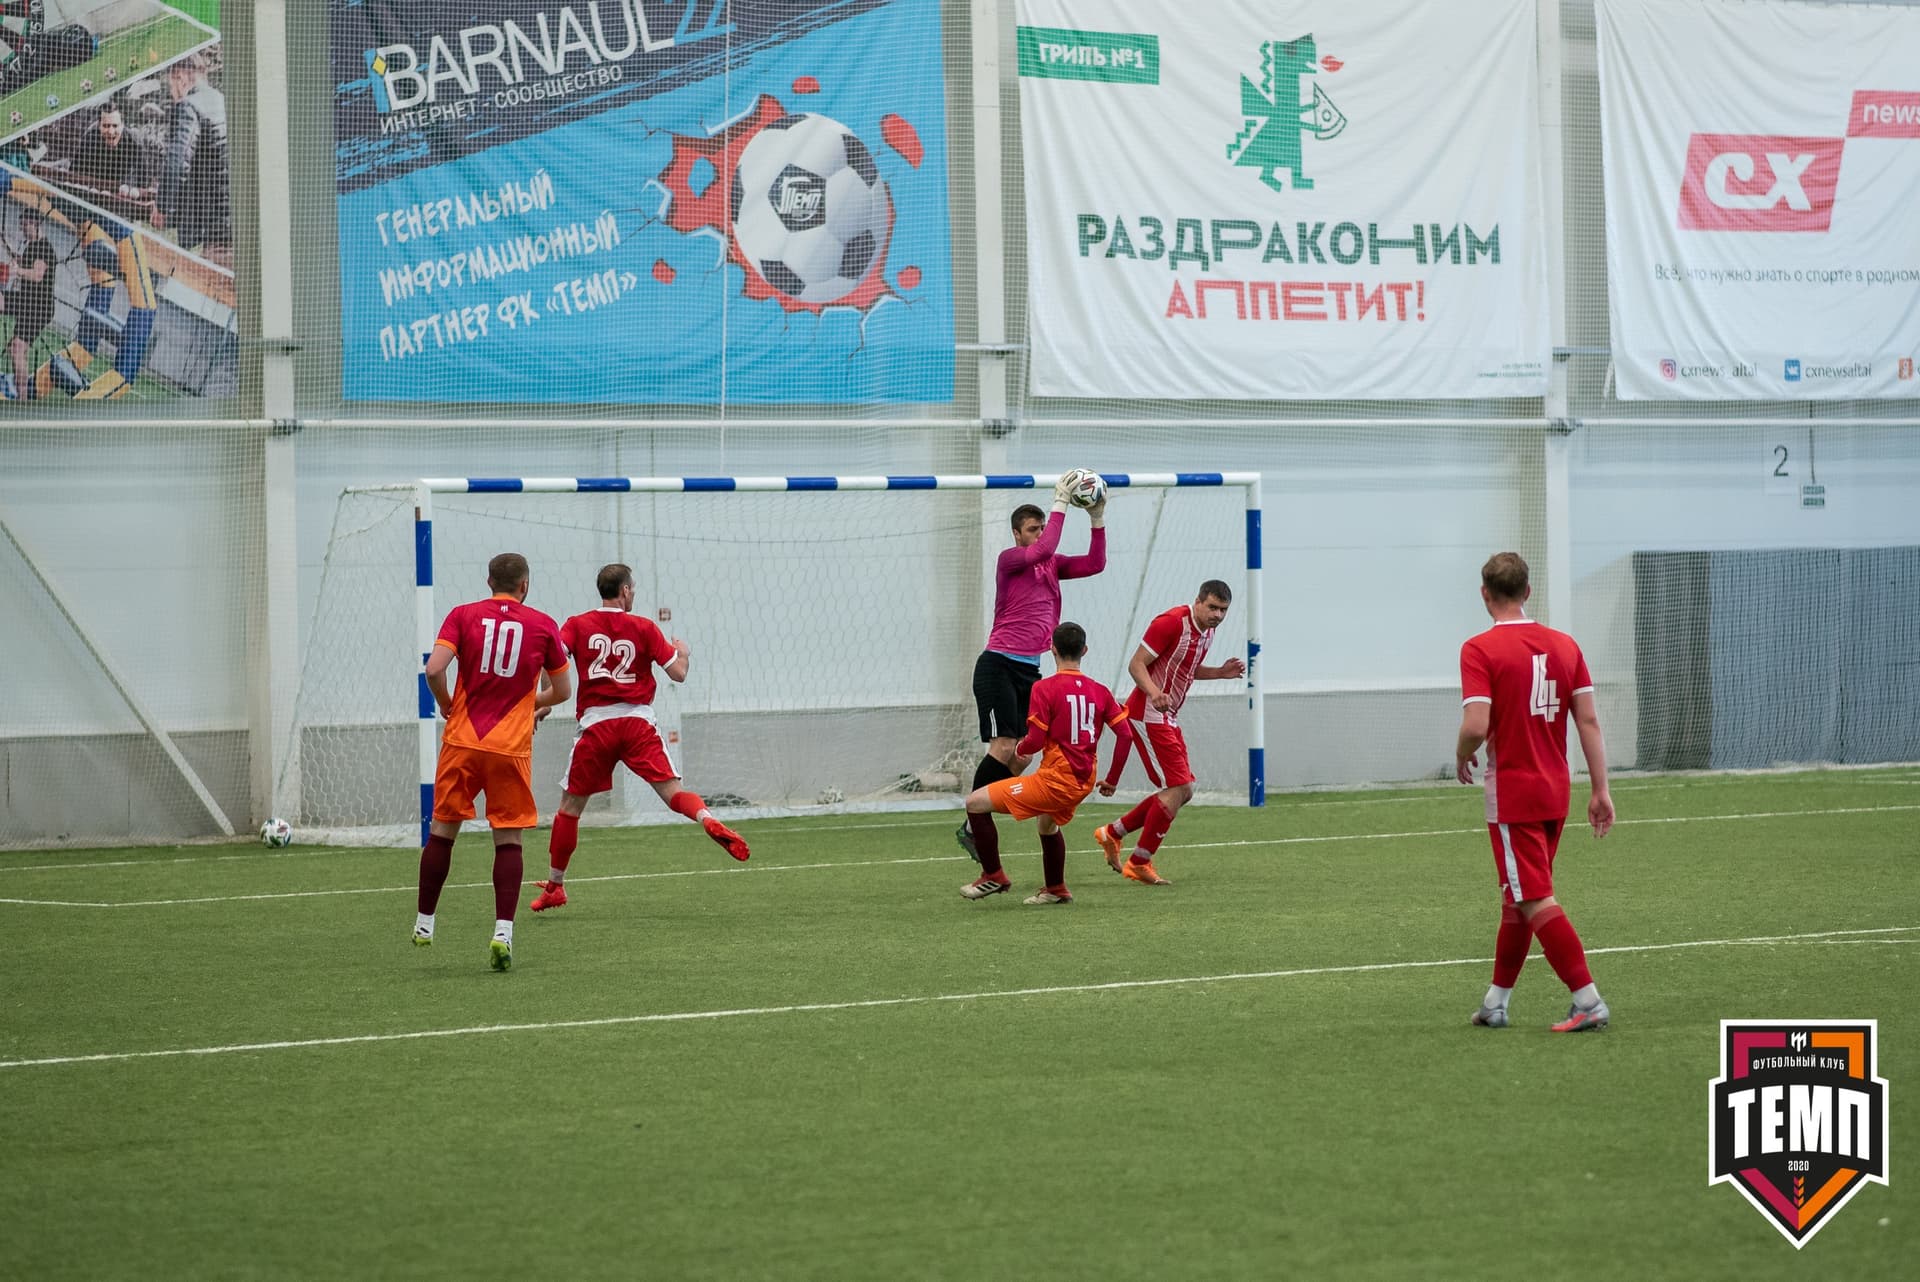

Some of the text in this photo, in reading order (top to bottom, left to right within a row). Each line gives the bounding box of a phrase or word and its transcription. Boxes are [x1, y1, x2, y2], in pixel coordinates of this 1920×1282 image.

[1039, 42, 1145, 69] ГРИЛЬ №1
[380, 98, 476, 134] ИНТЕРНЕТ
[494, 64, 622, 109] СООБЩЕСТВО
[376, 168, 555, 247] ГЕНЕРАЛЬНЫЙ
[379, 209, 620, 307] ИНФОРМАЦИОННЫЙ
[1076, 213, 1500, 272] РАЗДРАКОНИМ
[1164, 279, 1426, 322] АППЕТИТ!
[1711, 269, 1751, 286] нужно
[1755, 269, 1792, 282] знать
[1794, 270, 1803, 282] о
[1806, 269, 1852, 286] спорте
[1855, 270, 1863, 281] в
[1866, 269, 1920, 286] родном
[380, 268, 637, 361] ПАРТНЕР ФК «ТЕМП»
[1773, 445, 1789, 477] 2
[481, 617, 524, 678] 10
[588, 633, 637, 685] 22
[1530, 653, 1561, 723] 4
[1066, 694, 1096, 745] 14
